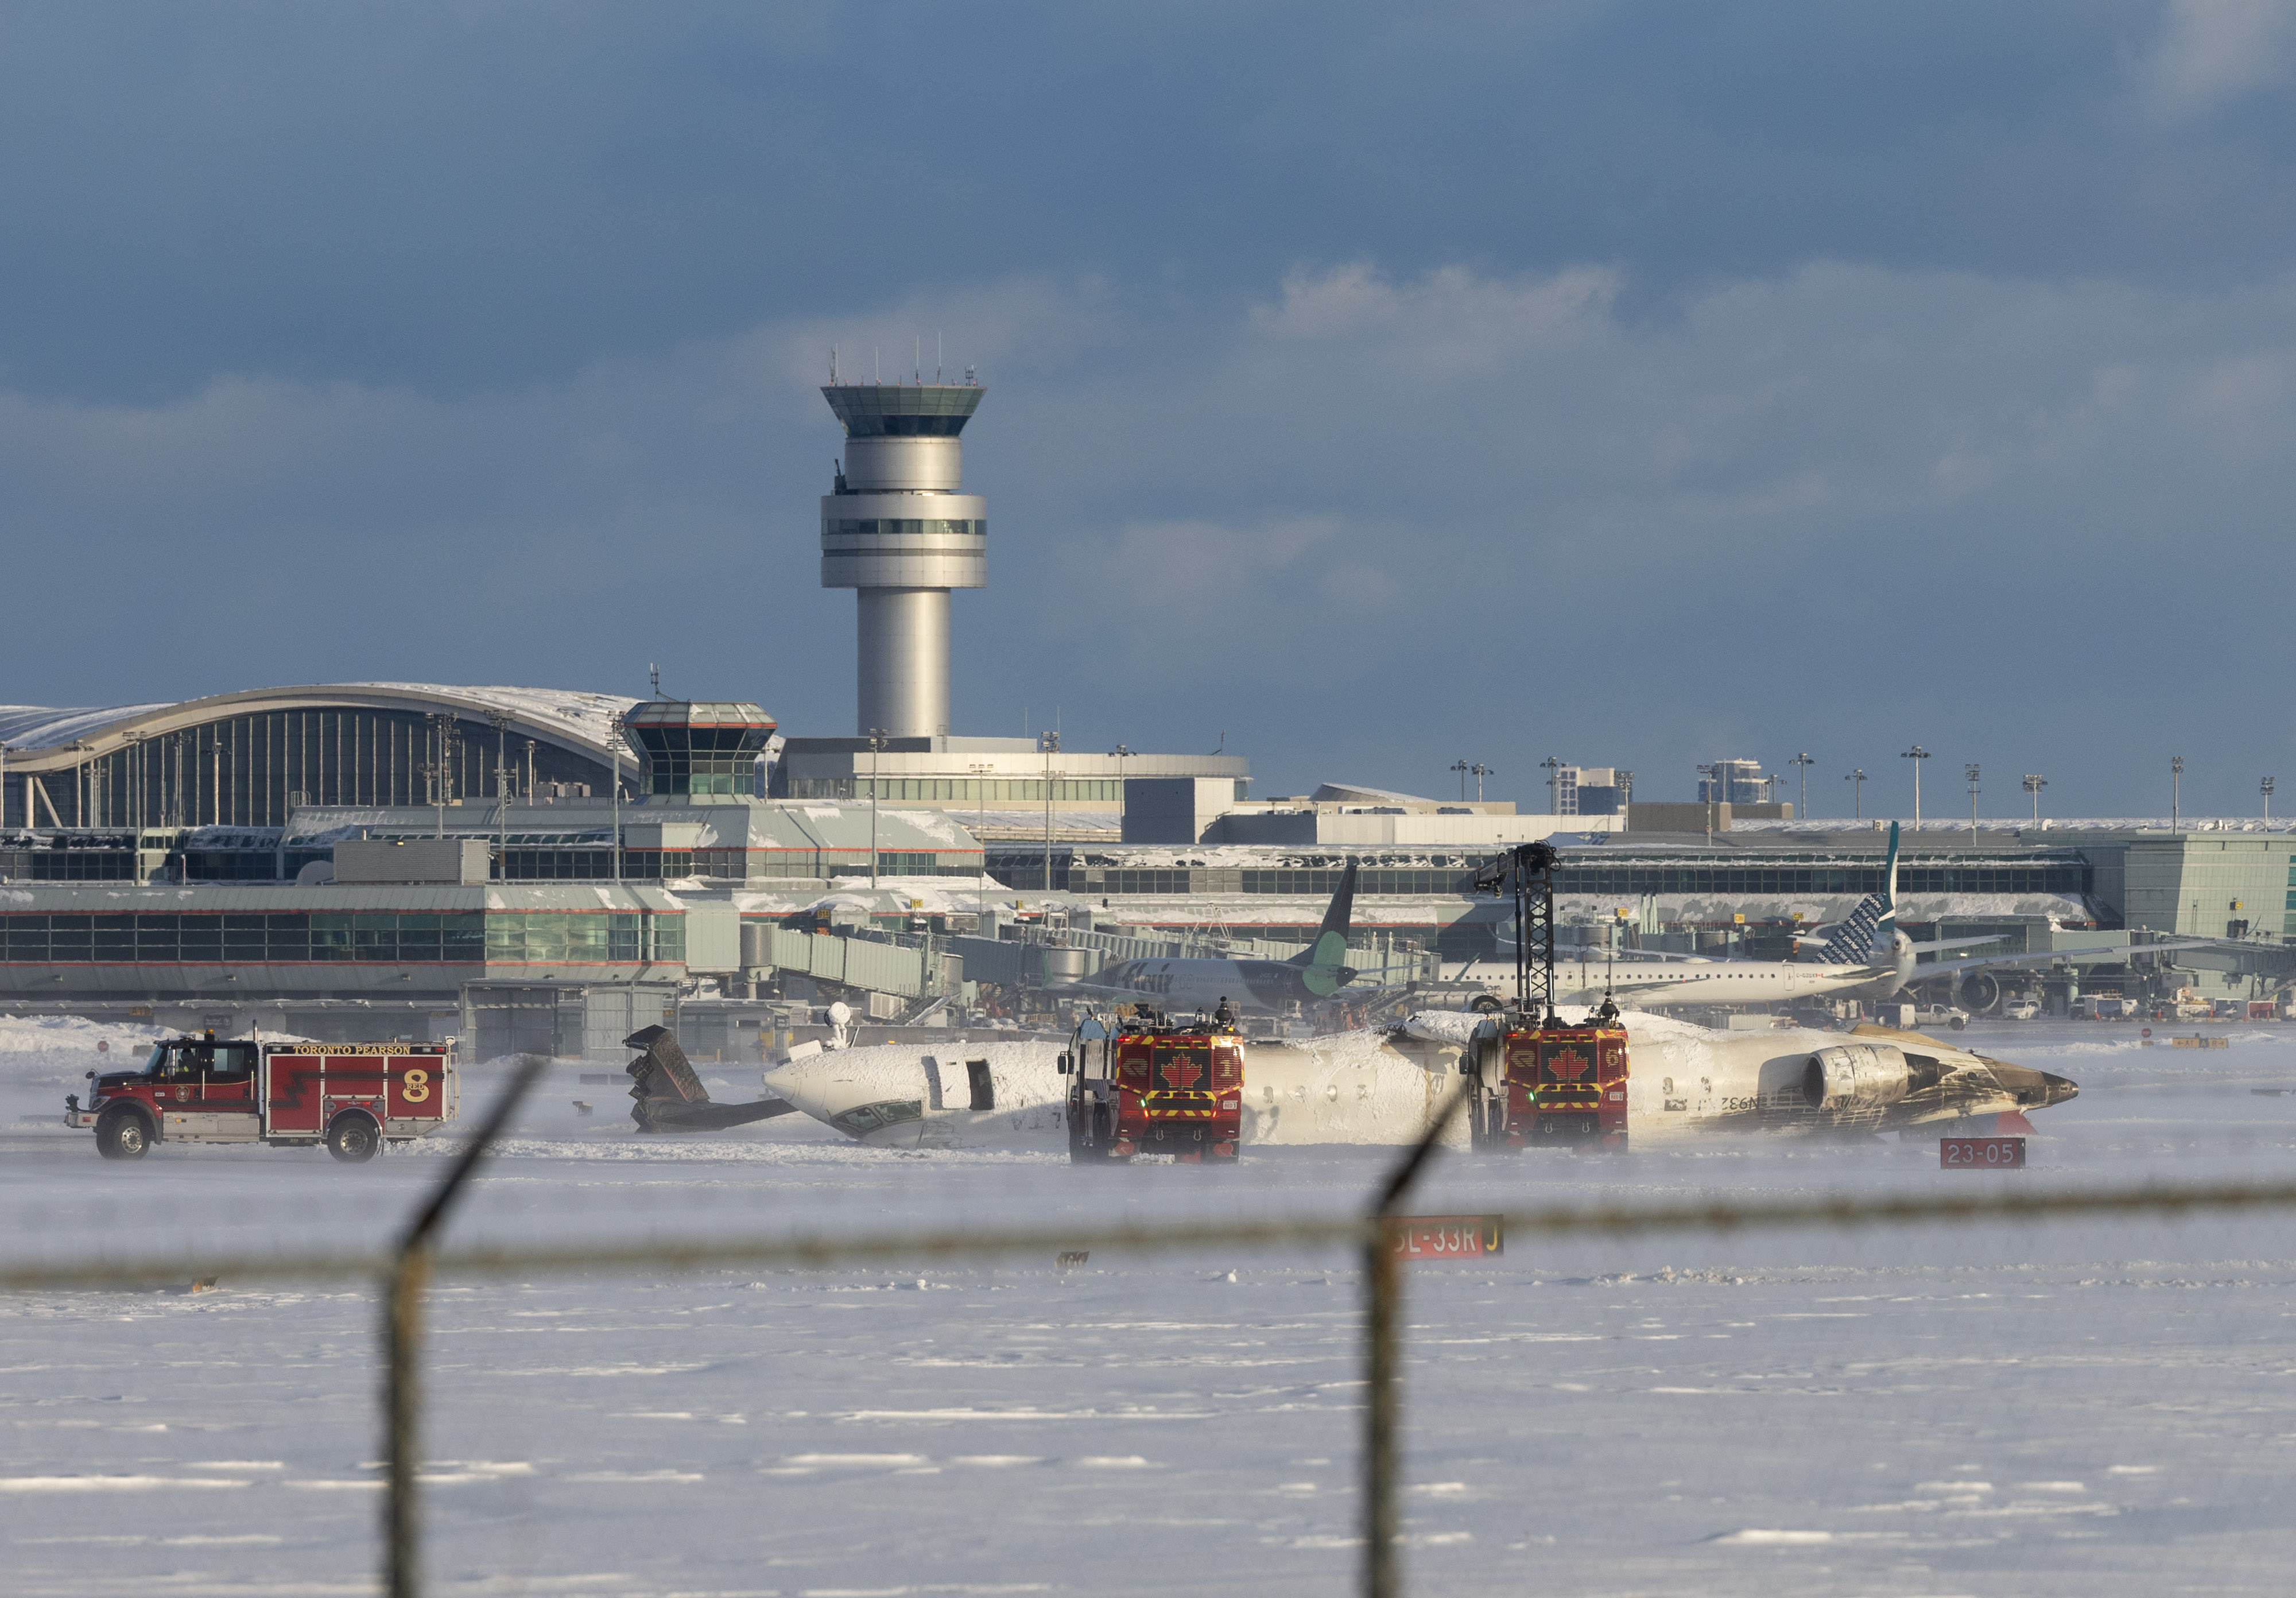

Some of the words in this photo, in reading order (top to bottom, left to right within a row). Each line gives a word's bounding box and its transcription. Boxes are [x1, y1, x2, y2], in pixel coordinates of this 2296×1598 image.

[1843, 935, 1859, 949] porter
[1121, 962, 1174, 994] flair
[293, 1046, 351, 1054] TORONTO
[355, 1046, 411, 1055] PEARSON
[1605, 1049, 1619, 1066] 6
[1220, 1060, 1234, 1077] 1
[402, 1069, 429, 1103] 8
[406, 1083, 424, 1091] RED
[1946, 1143, 2014, 1163] 23-05
[1486, 1224, 1498, 1252] J
